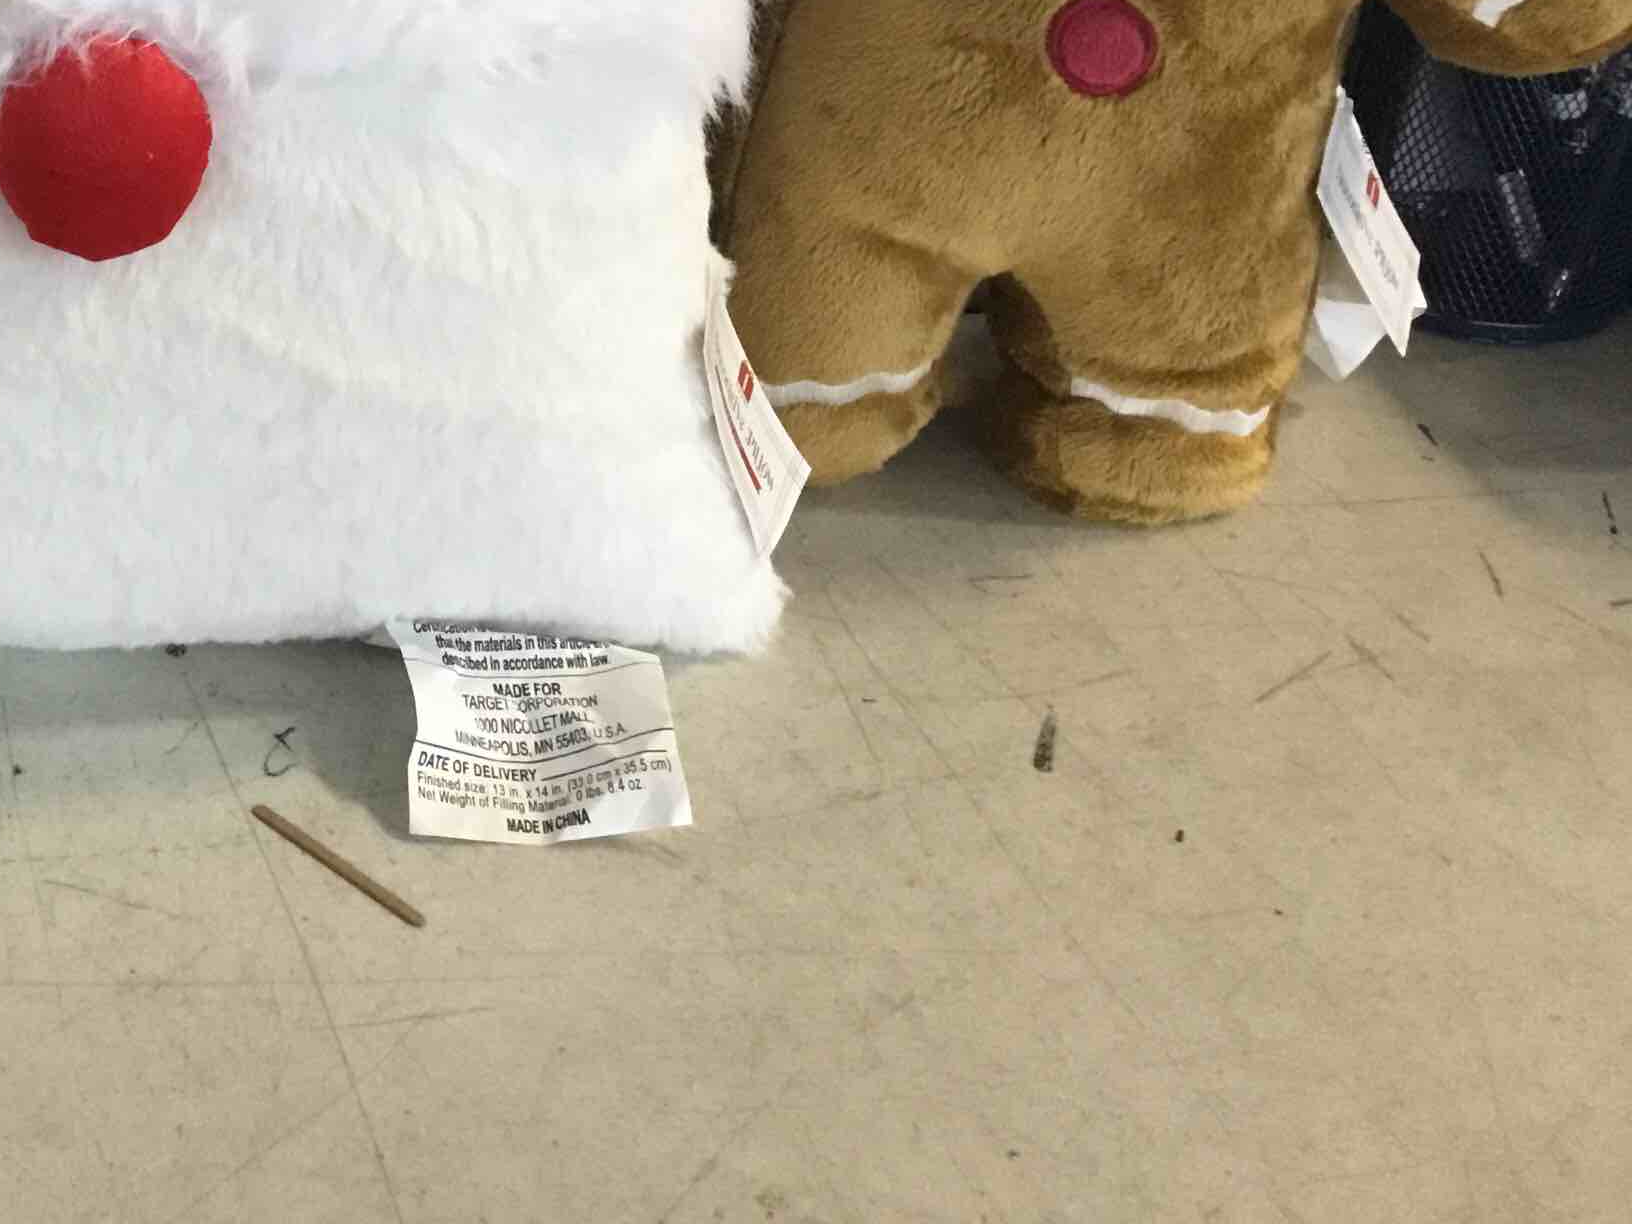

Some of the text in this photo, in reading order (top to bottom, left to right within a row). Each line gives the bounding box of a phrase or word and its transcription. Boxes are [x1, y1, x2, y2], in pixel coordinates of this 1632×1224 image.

[455, 638, 472, 652] the
[474, 635, 523, 652] materials
[525, 636, 535, 650] in
[490, 656, 501, 671] in
[503, 654, 564, 671] accordance
[565, 653, 589, 669] with
[492, 682, 562, 698] MADE FOR
[462, 693, 509, 711] TARGET
[501, 714, 559, 734] NICOLLET
[560, 711, 594, 727] MALL
[534, 738, 554, 755] MN
[417, 751, 537, 783] DATE OF DELIVERY
[417, 770, 461, 791] Finished
[536, 785, 549, 797] 14
[623, 758, 649, 775] 35.5
[650, 757, 673, 773] cm)
[417, 786, 436, 800] Net
[439, 790, 476, 808] Weight
[506, 807, 593, 834] MADE IN CHINA
